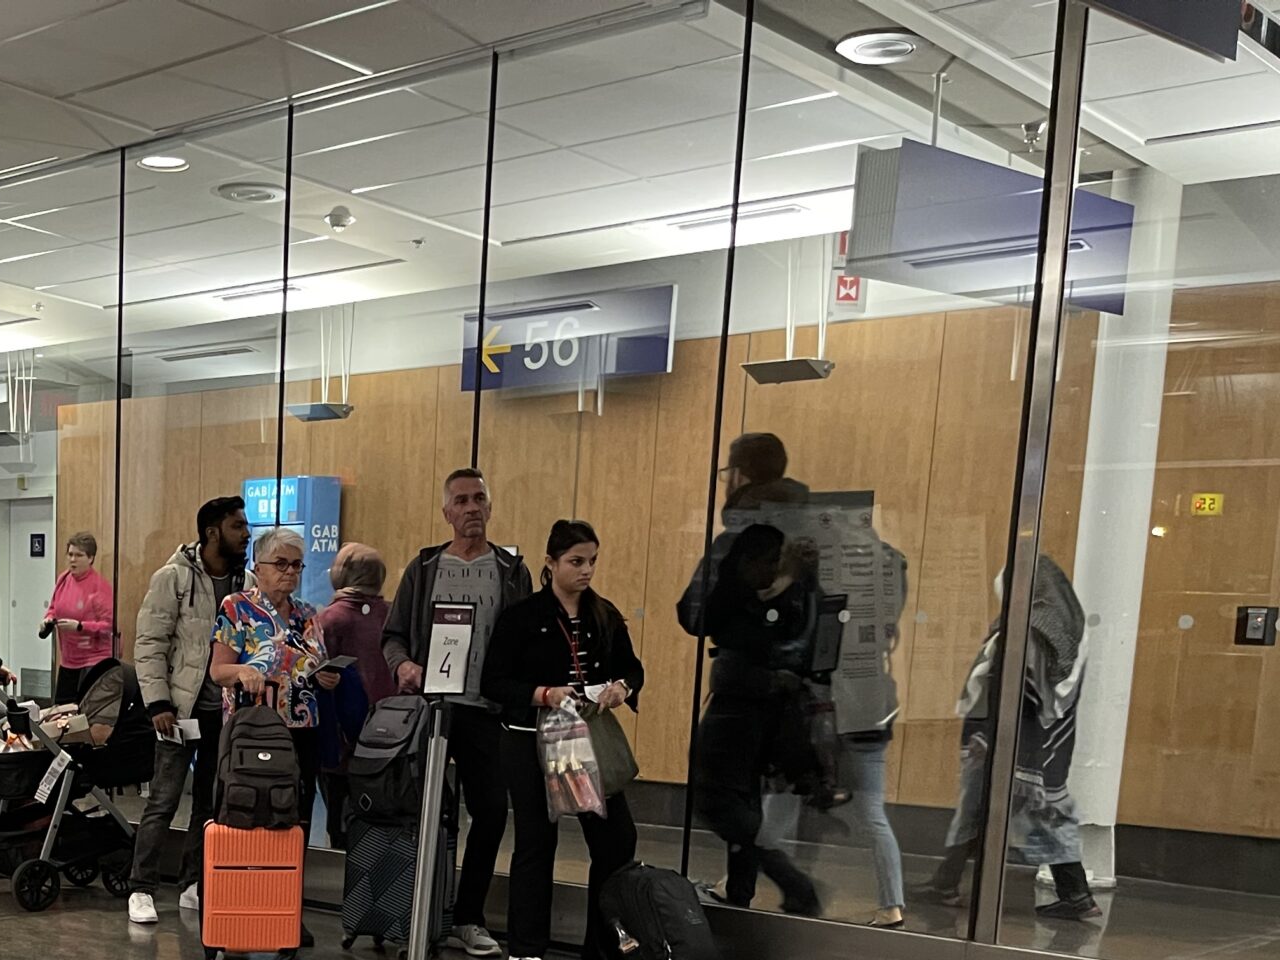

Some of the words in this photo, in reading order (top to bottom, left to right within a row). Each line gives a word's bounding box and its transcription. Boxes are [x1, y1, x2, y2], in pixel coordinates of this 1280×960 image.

[523, 316, 580, 370] 56
[247, 486, 267, 498] GAB
[311, 525, 339, 538] GAB
[311, 539, 338, 552] ATM
[442, 636, 459, 646] Zone
[439, 651, 452, 679] 4
